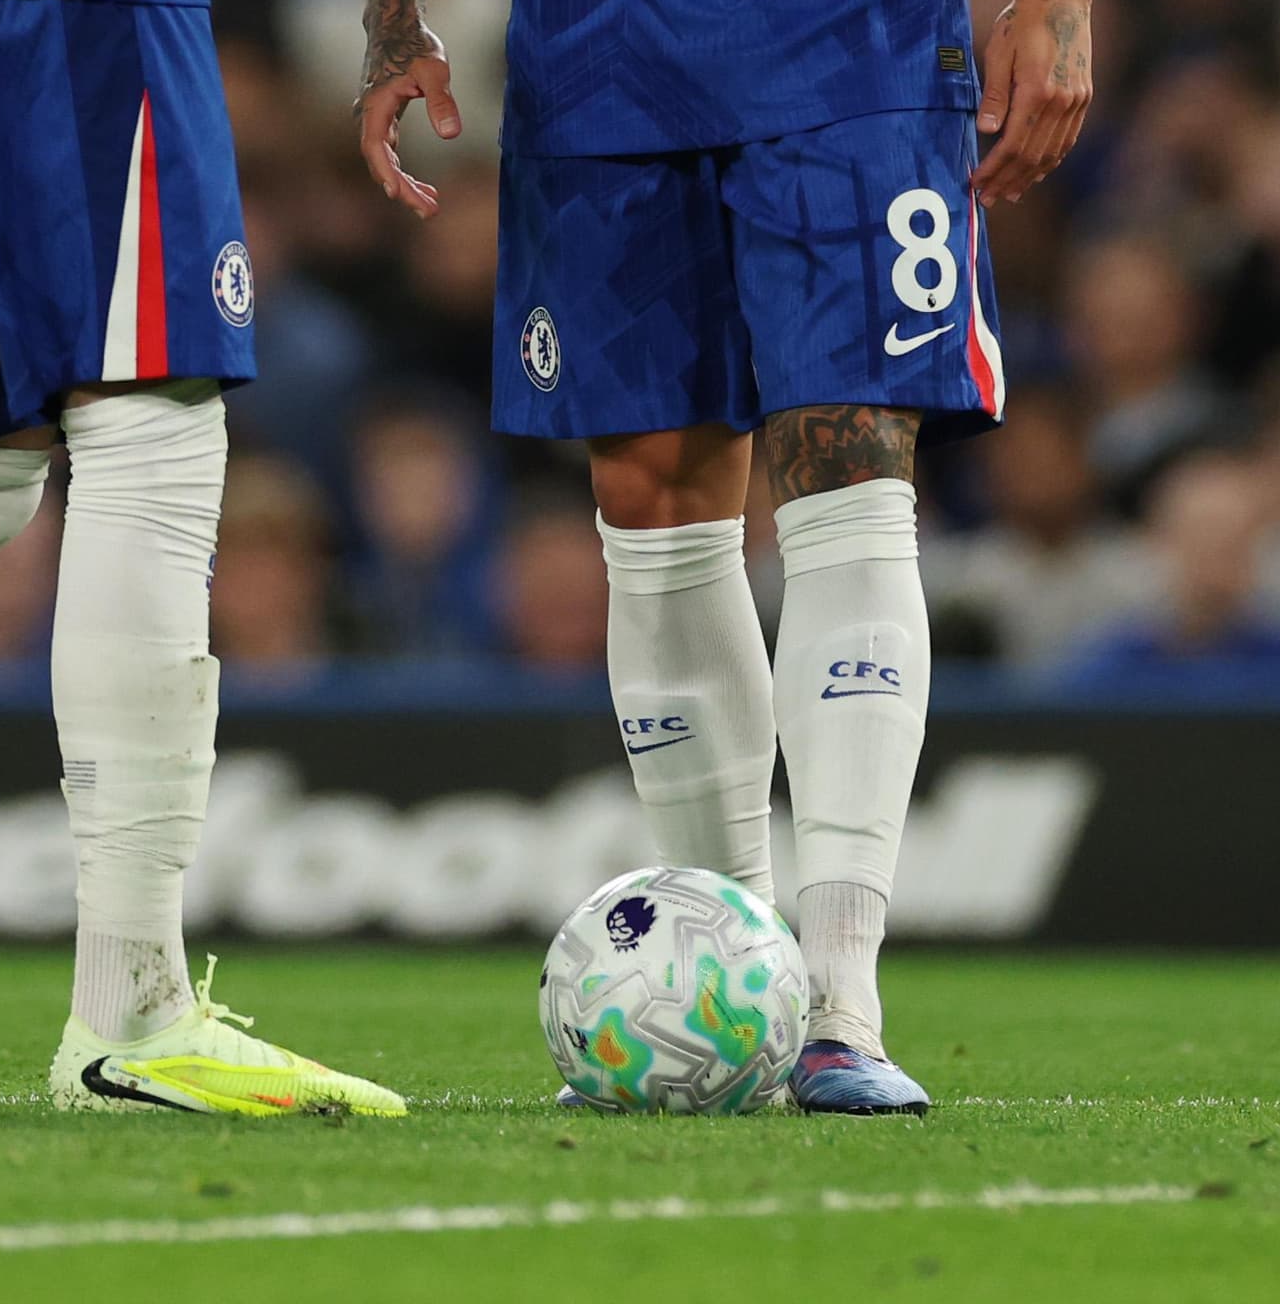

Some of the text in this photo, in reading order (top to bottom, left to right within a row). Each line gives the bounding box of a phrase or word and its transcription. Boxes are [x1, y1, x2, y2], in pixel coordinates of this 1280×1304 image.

[886, 188, 958, 313] 8
[828, 661, 901, 687] CFC
[622, 716, 689, 735] CFC
